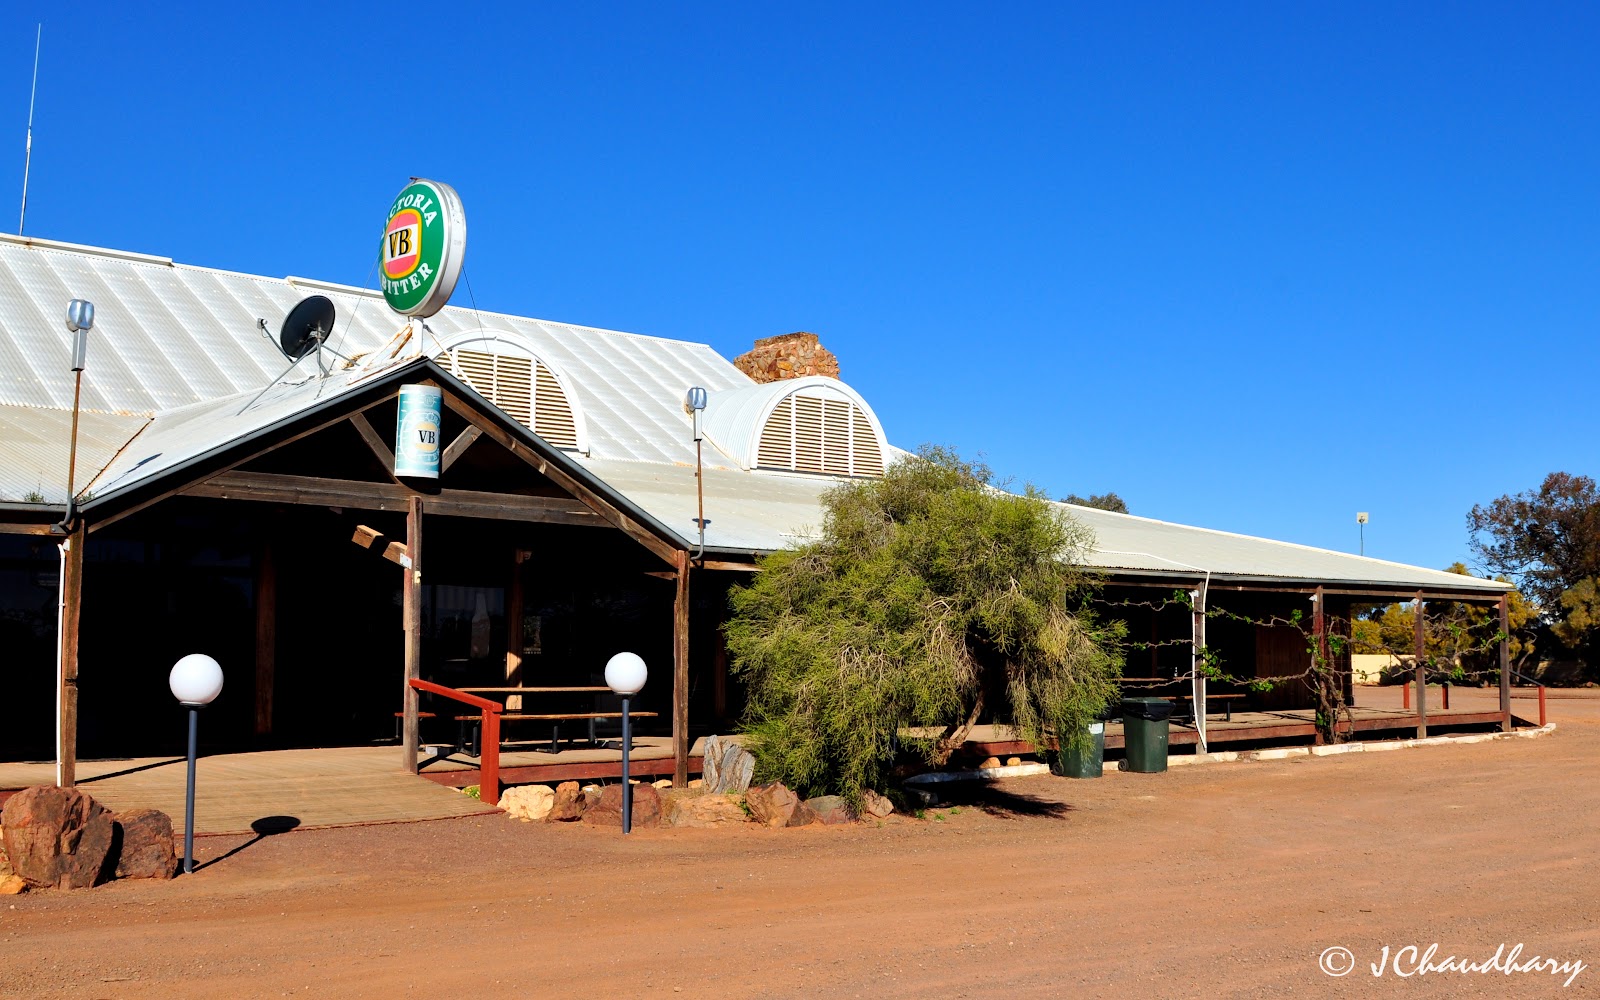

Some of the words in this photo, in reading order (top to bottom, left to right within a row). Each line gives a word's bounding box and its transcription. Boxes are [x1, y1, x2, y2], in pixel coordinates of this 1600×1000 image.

[389, 228, 412, 258] VB
[381, 262, 434, 295] BITTER
[418, 429, 436, 444] VB
